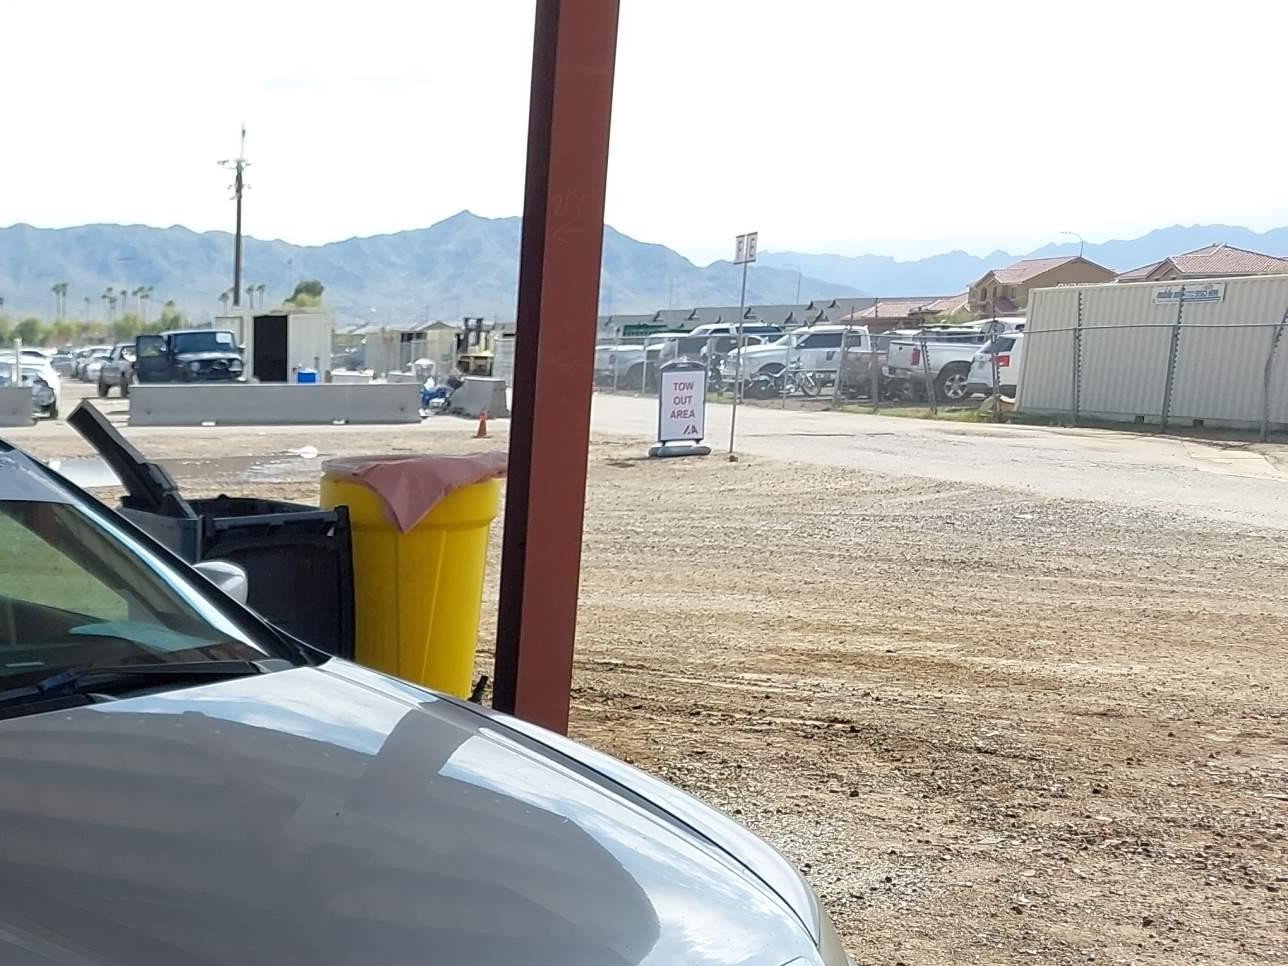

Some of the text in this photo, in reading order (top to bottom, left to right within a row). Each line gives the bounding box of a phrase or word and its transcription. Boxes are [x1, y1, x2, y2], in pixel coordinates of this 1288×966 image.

[673, 382, 694, 391] TOW
[673, 395, 693, 405] OUT
[670, 410, 695, 419] AREA
